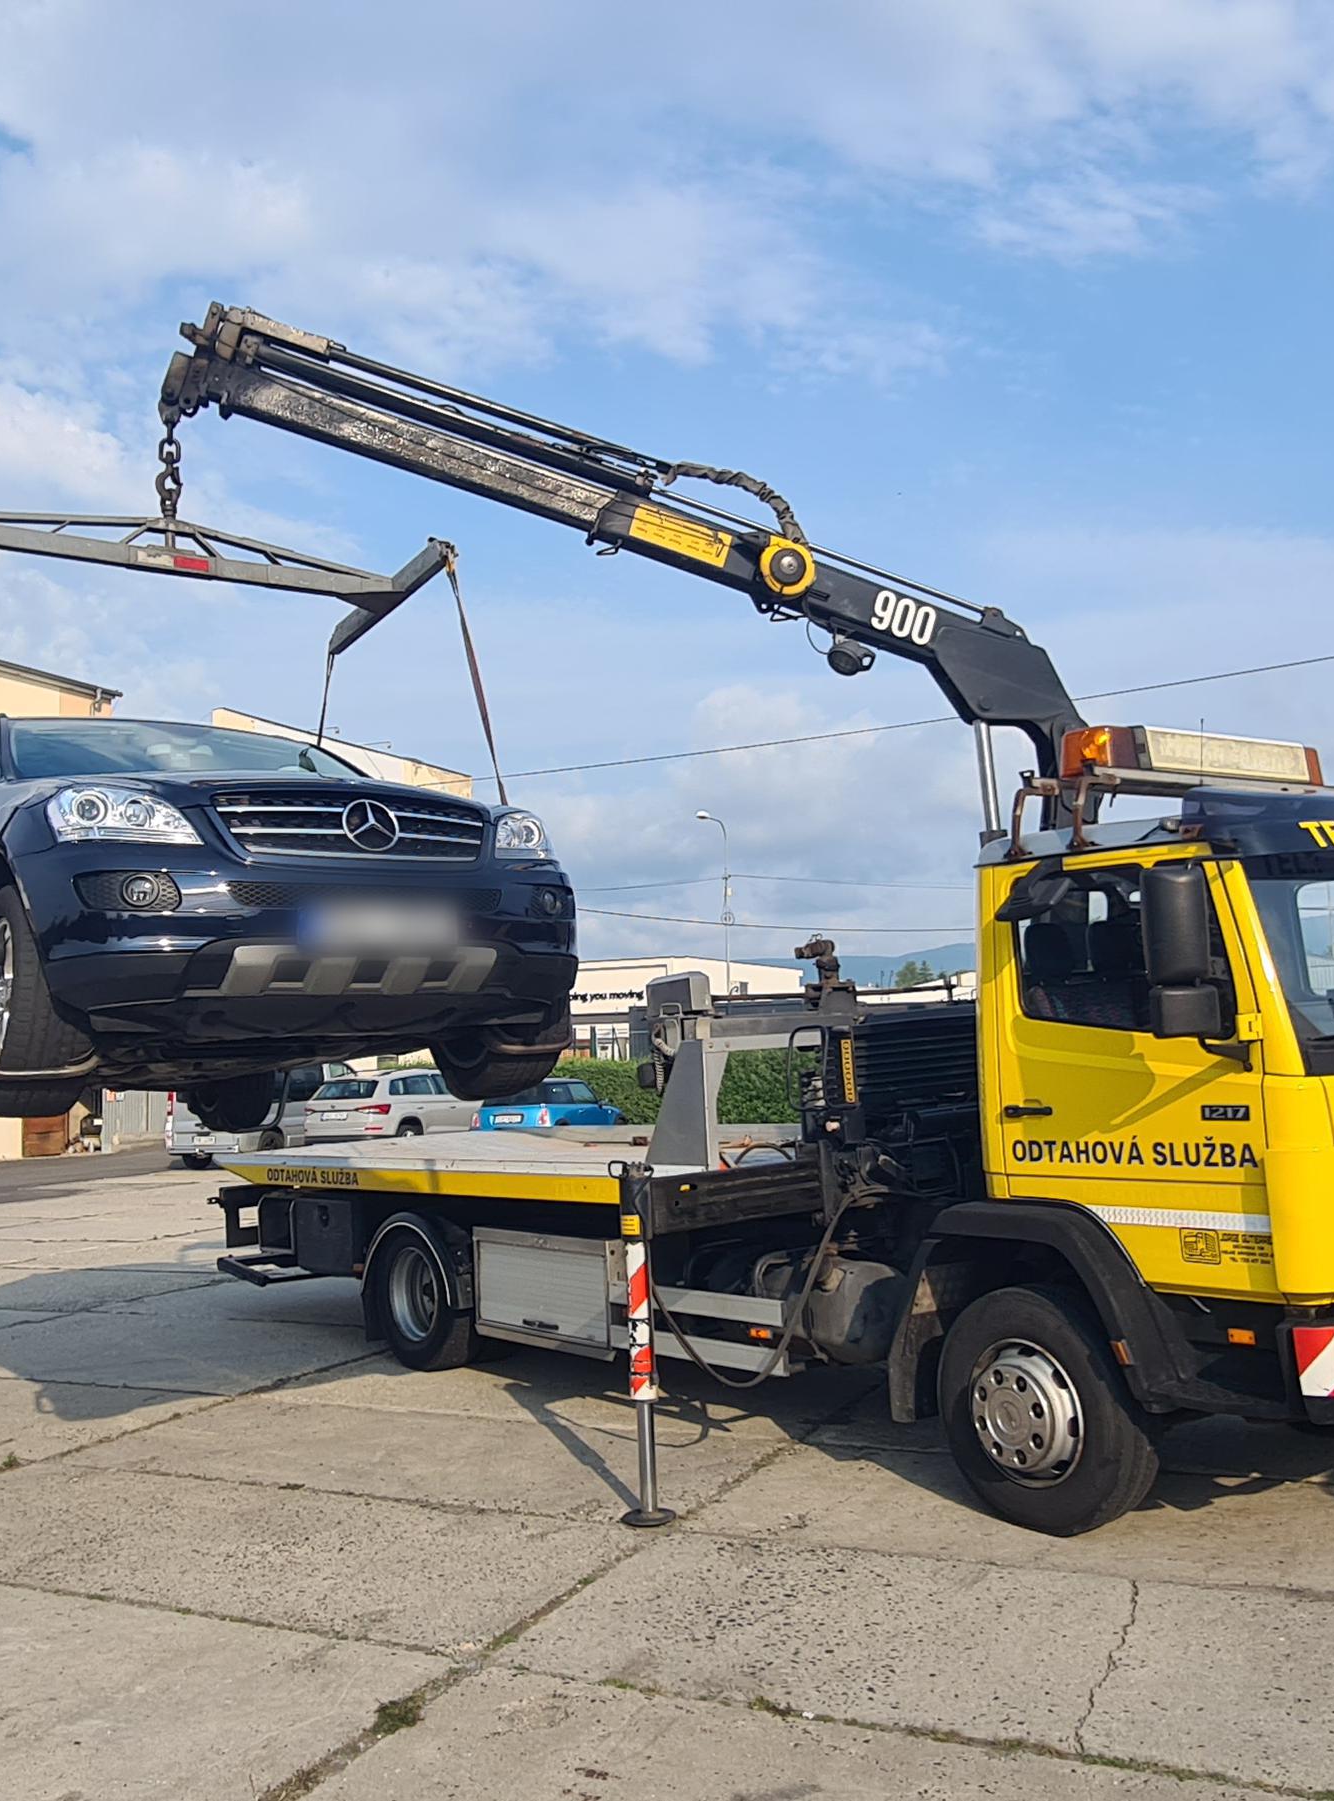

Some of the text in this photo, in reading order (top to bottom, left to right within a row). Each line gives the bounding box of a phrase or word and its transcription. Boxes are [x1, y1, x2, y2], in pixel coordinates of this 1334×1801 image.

[870, 590, 937, 646] 900
[589, 993, 607, 1003] you
[609, 989, 645, 1002] moving
[1203, 1106, 1247, 1120] 1217
[1011, 1135, 1259, 1168] ODTAHOVÁ SLUŽBA
[267, 1166, 359, 1186] ODTAHOVÁ SLUŽBA
